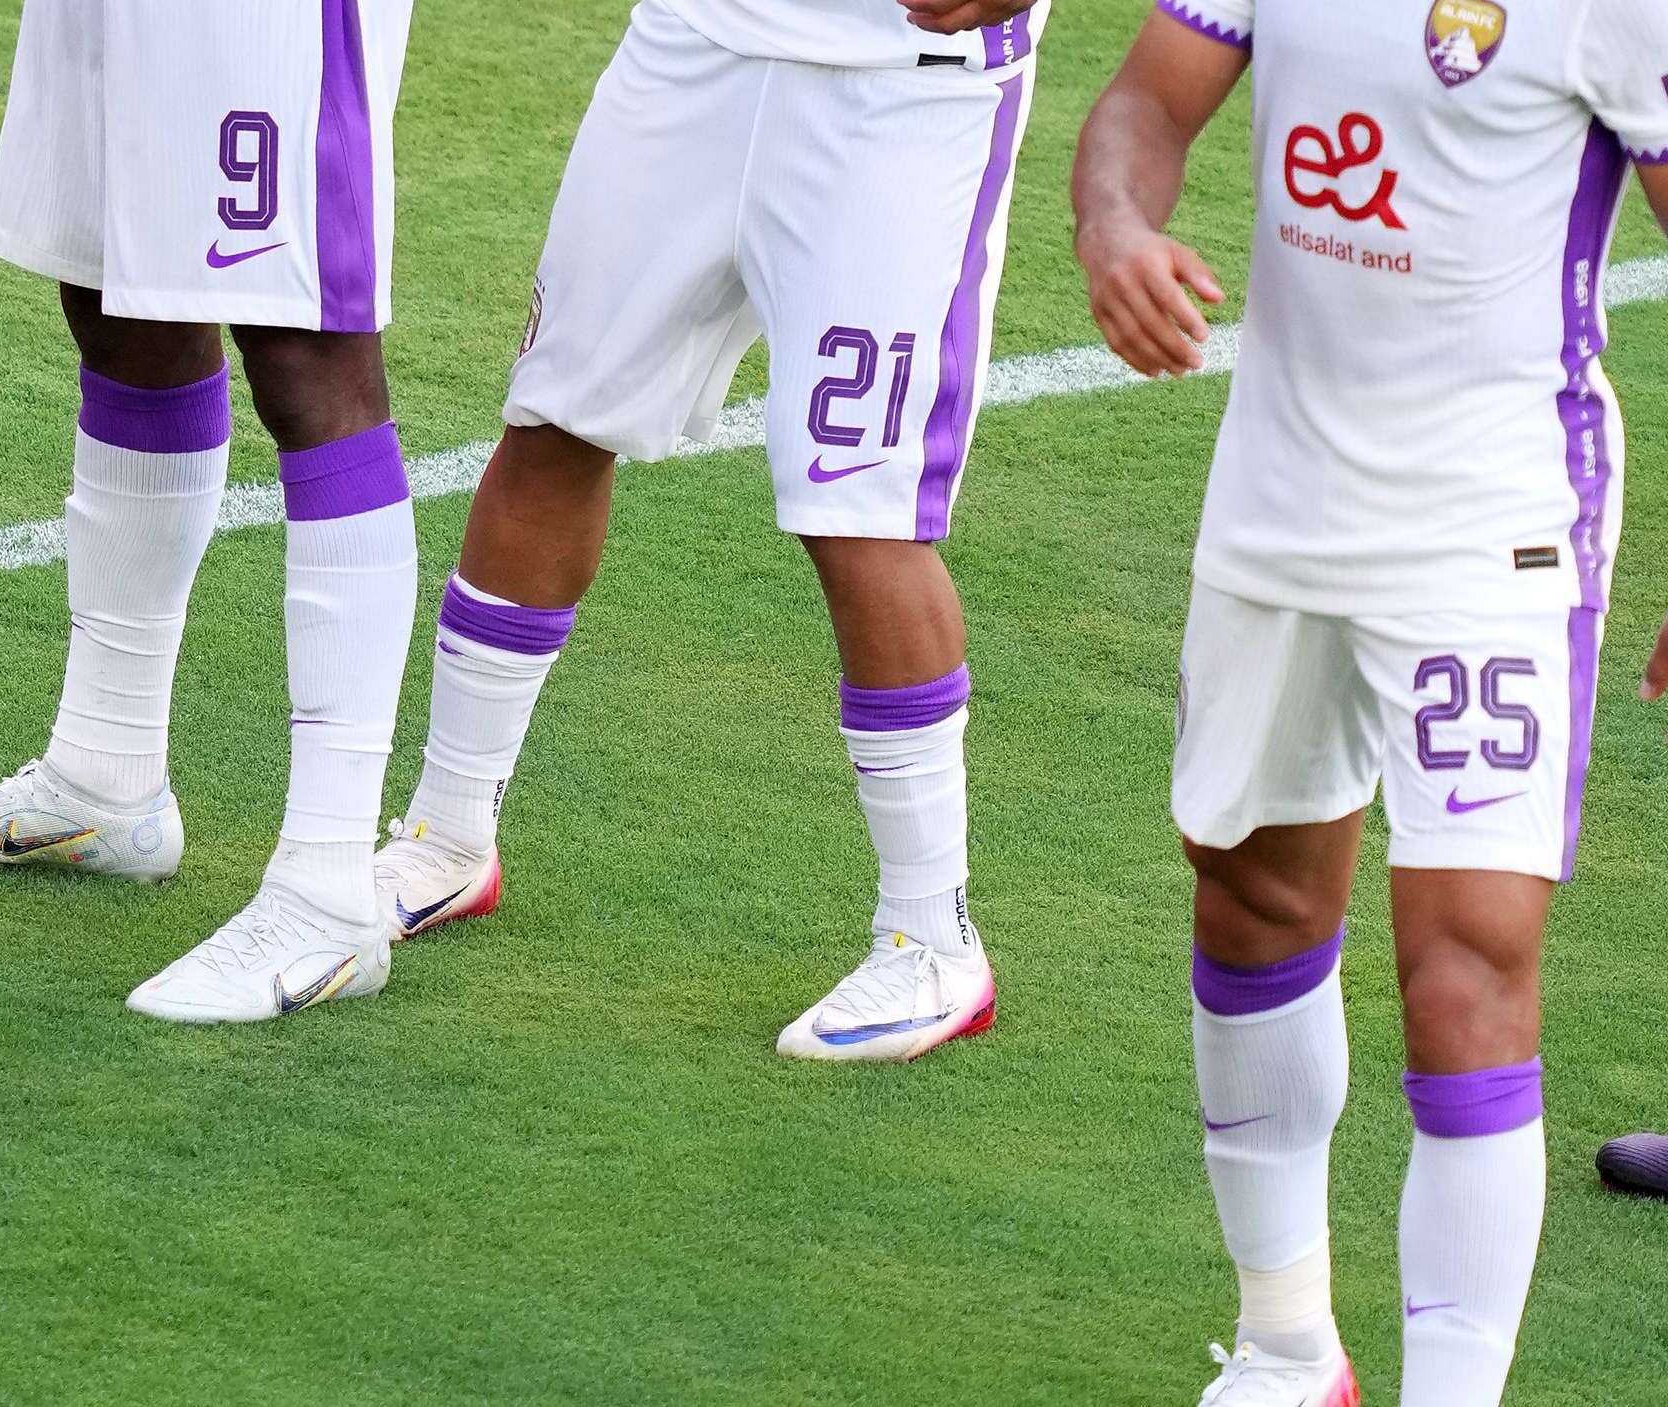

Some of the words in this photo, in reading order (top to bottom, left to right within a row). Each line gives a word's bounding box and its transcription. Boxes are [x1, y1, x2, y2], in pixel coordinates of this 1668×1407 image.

[1002, 38, 1014, 65] AIN
[217, 110, 280, 231] 9
[1278, 223, 1354, 263] etisalat
[1362, 249, 1411, 273] and
[1574, 258, 1589, 308] 1968
[807, 325, 916, 448] 21
[1413, 654, 1540, 772] 25
